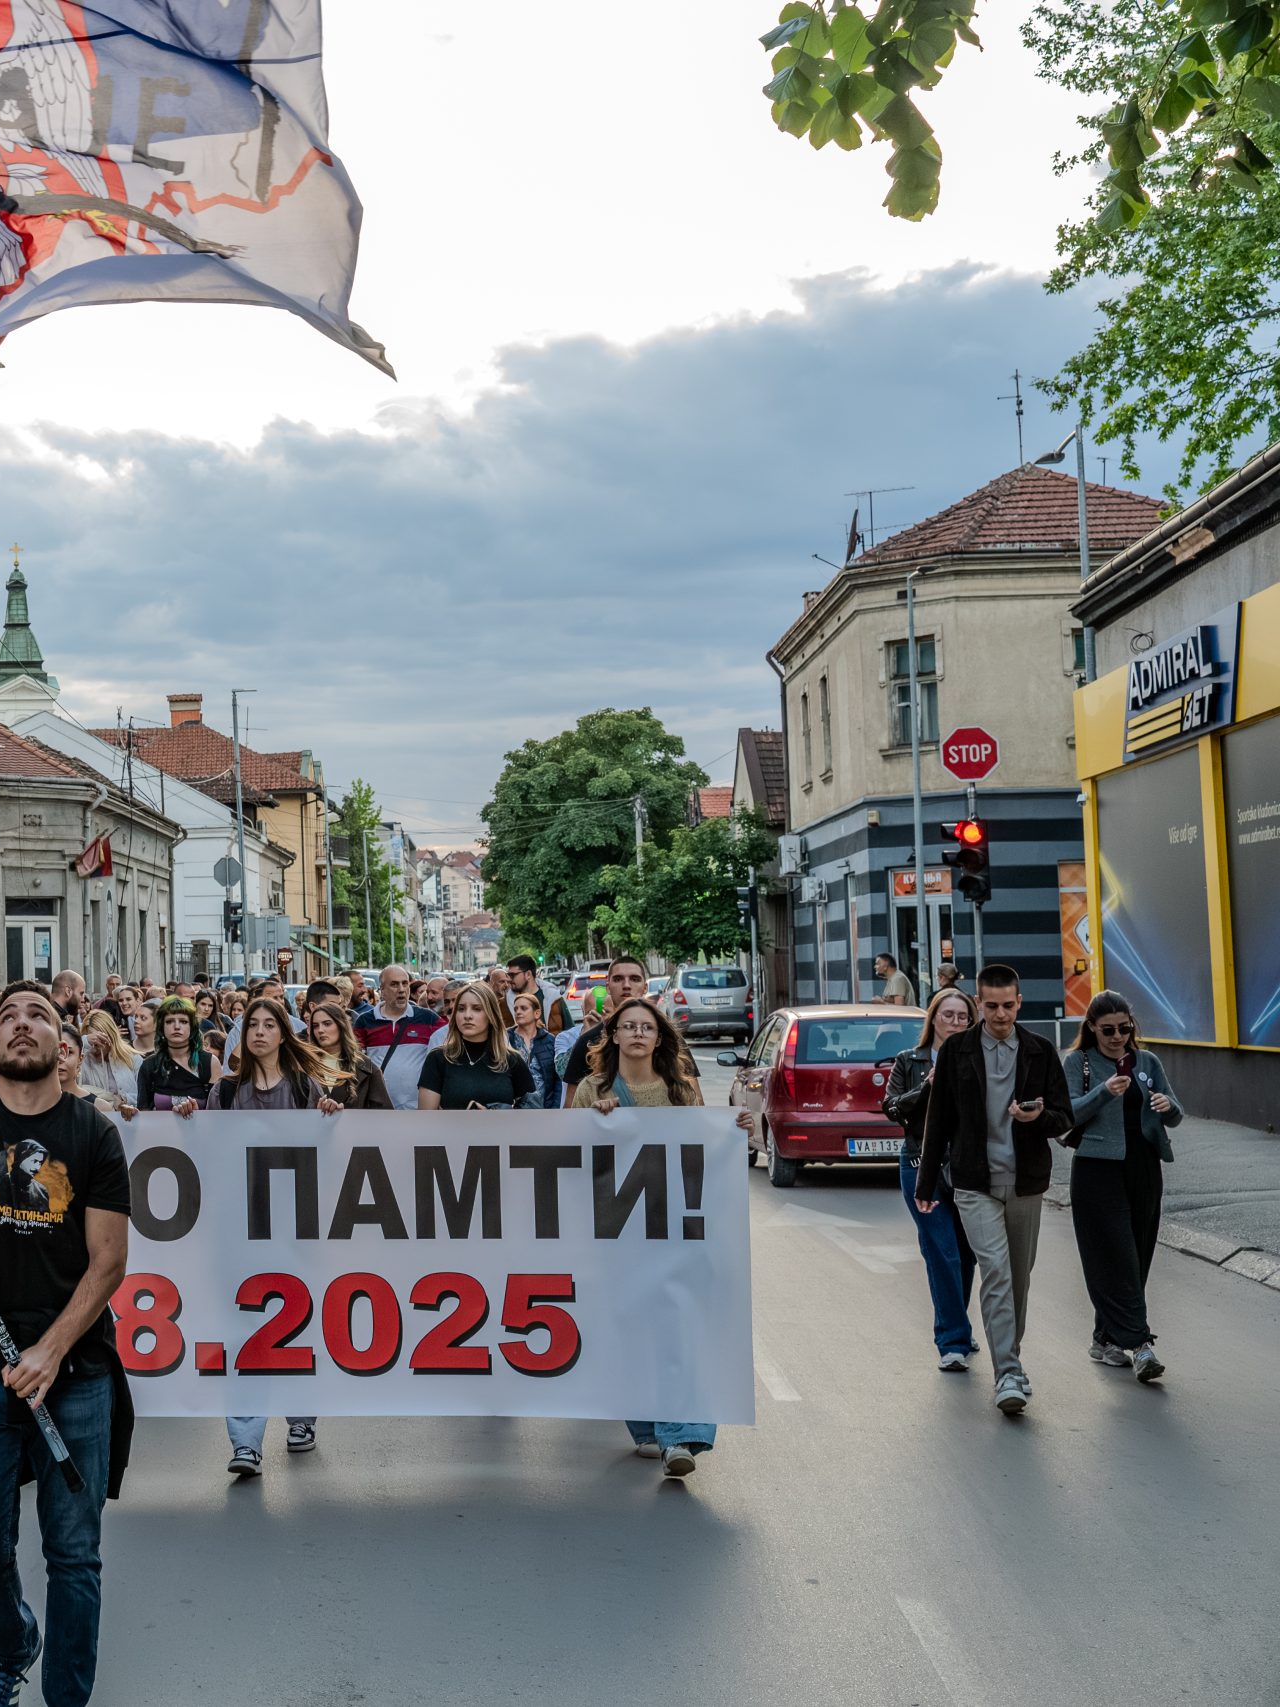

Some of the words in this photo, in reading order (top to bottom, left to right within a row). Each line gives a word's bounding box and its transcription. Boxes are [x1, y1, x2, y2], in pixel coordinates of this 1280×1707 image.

[1128, 626, 1213, 711] ADMIRAL
[1182, 684, 1213, 732] BET
[948, 743, 992, 764] STOP
[856, 1141, 870, 1152] VA
[246, 1143, 705, 1240] ПАМТИ!
